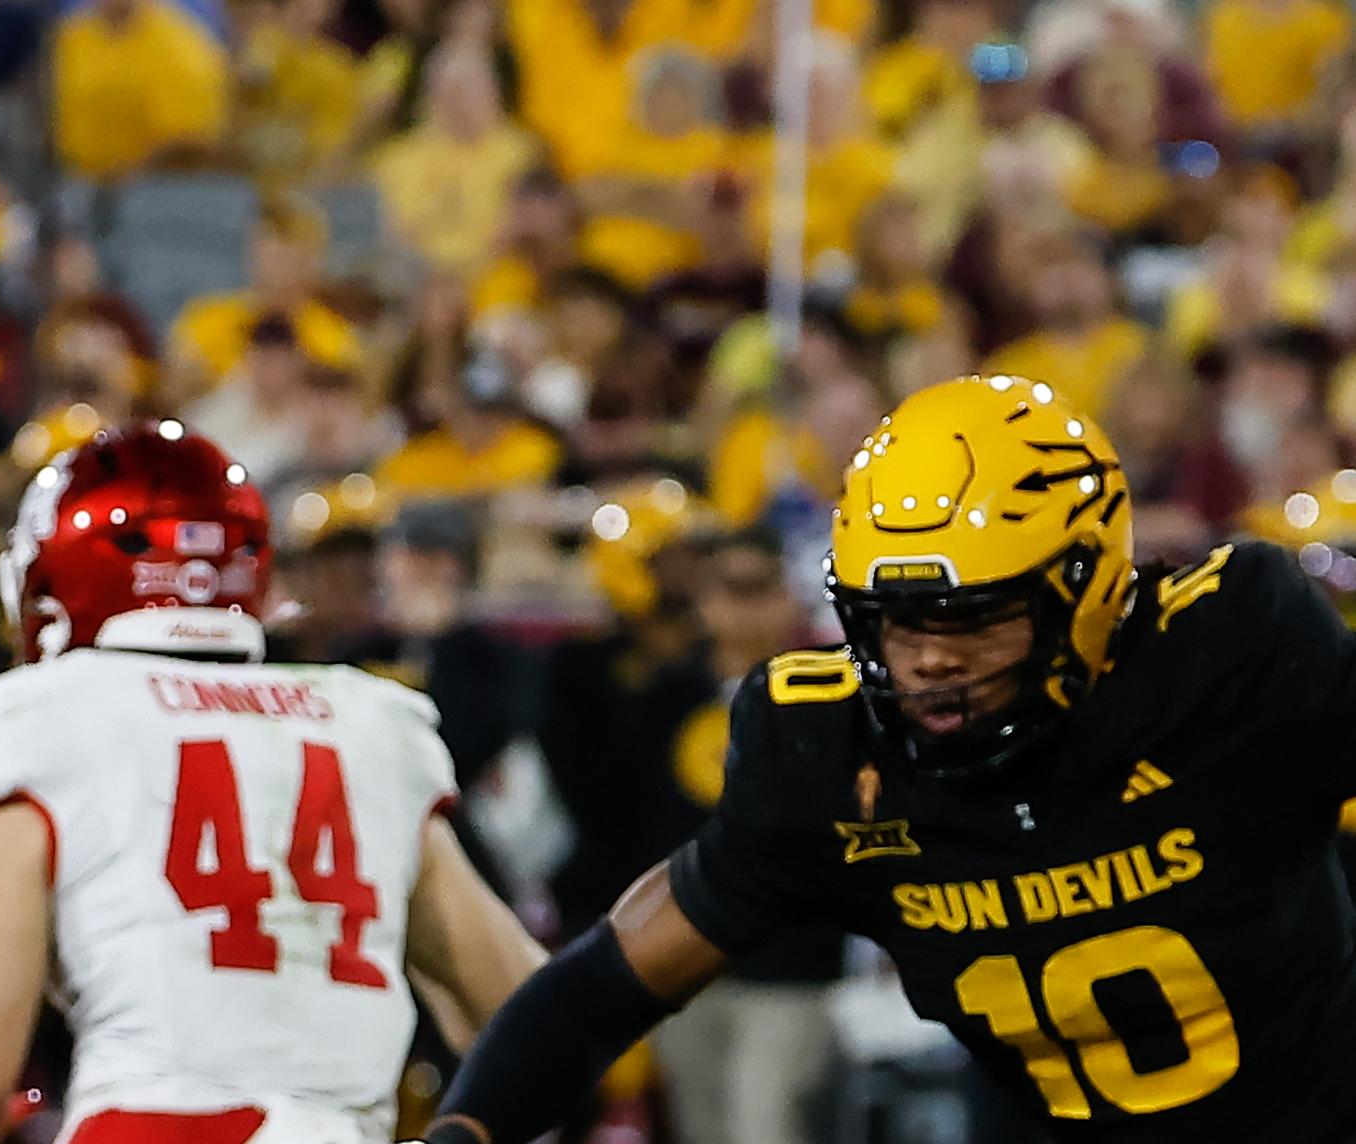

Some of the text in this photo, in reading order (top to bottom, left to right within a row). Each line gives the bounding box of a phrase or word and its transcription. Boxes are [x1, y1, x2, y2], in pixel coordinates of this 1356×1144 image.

[164, 738, 391, 990] 44
[892, 827, 1204, 934] SUN DEVILS
[953, 925, 1240, 1120] 10
